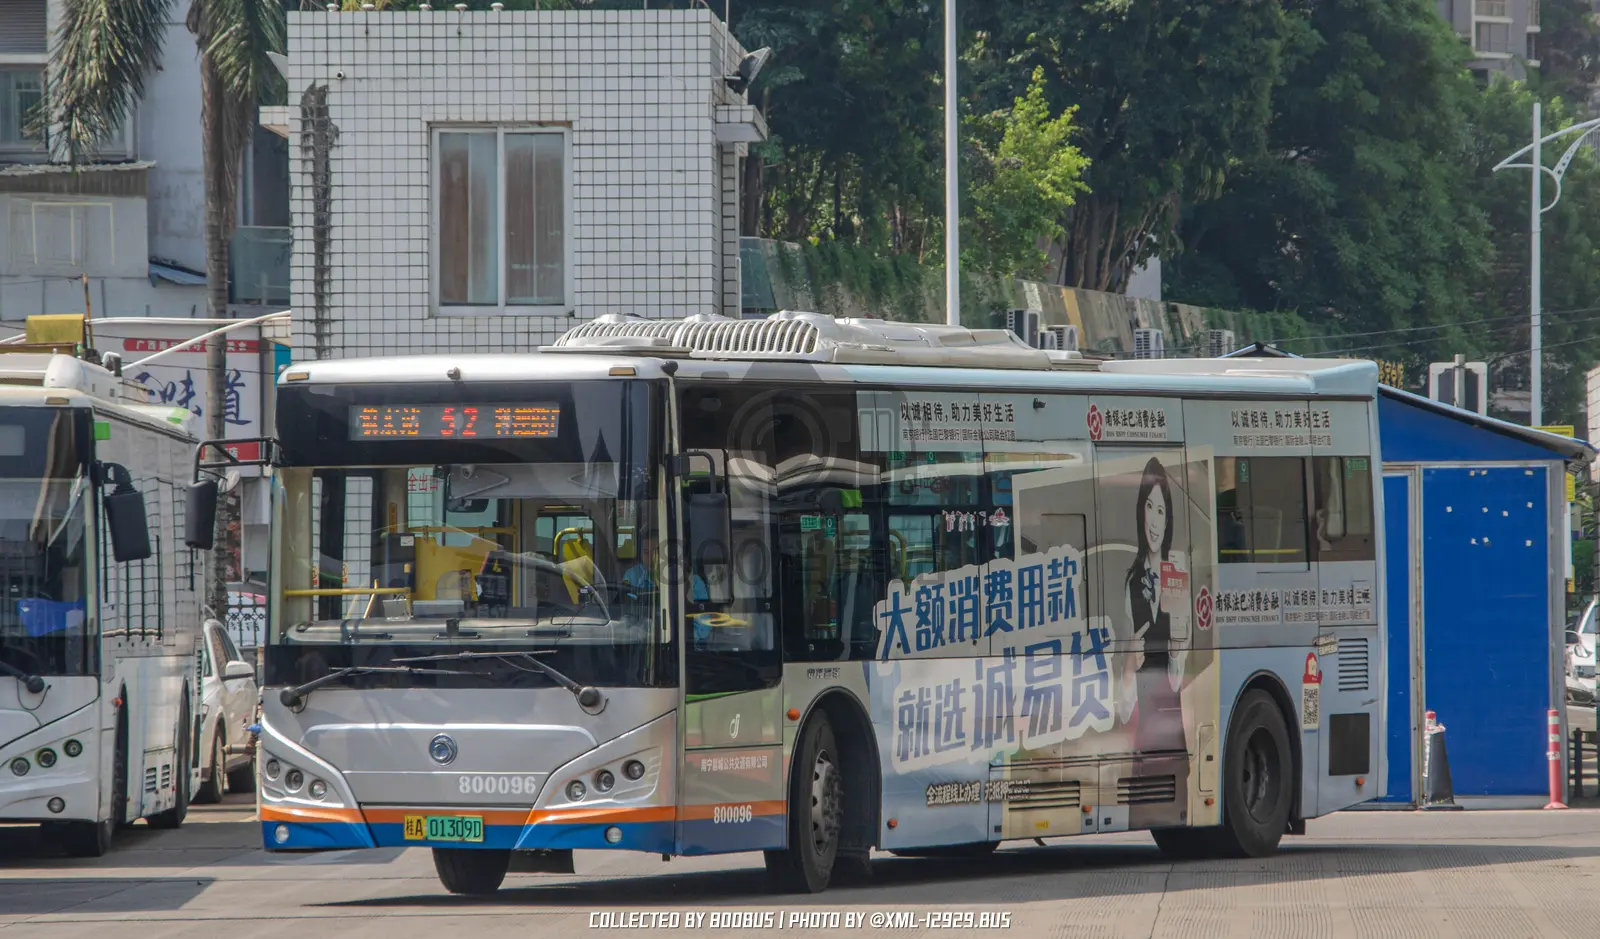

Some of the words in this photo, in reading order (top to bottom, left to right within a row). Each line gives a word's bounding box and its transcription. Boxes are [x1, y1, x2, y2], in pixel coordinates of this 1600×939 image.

[134, 368, 252, 425] 味道
[441, 407, 479, 436] 52
[1105, 408, 1166, 428] 南银法巴消费金融
[880, 556, 1077, 663] 大额消费用款
[1216, 591, 1279, 612] 南银法巴消费金融
[896, 627, 1112, 763] 就选诚易贷
[459, 776, 537, 794] 800096
[714, 805, 752, 824] 800096
[430, 820, 482, 838] 01309D
